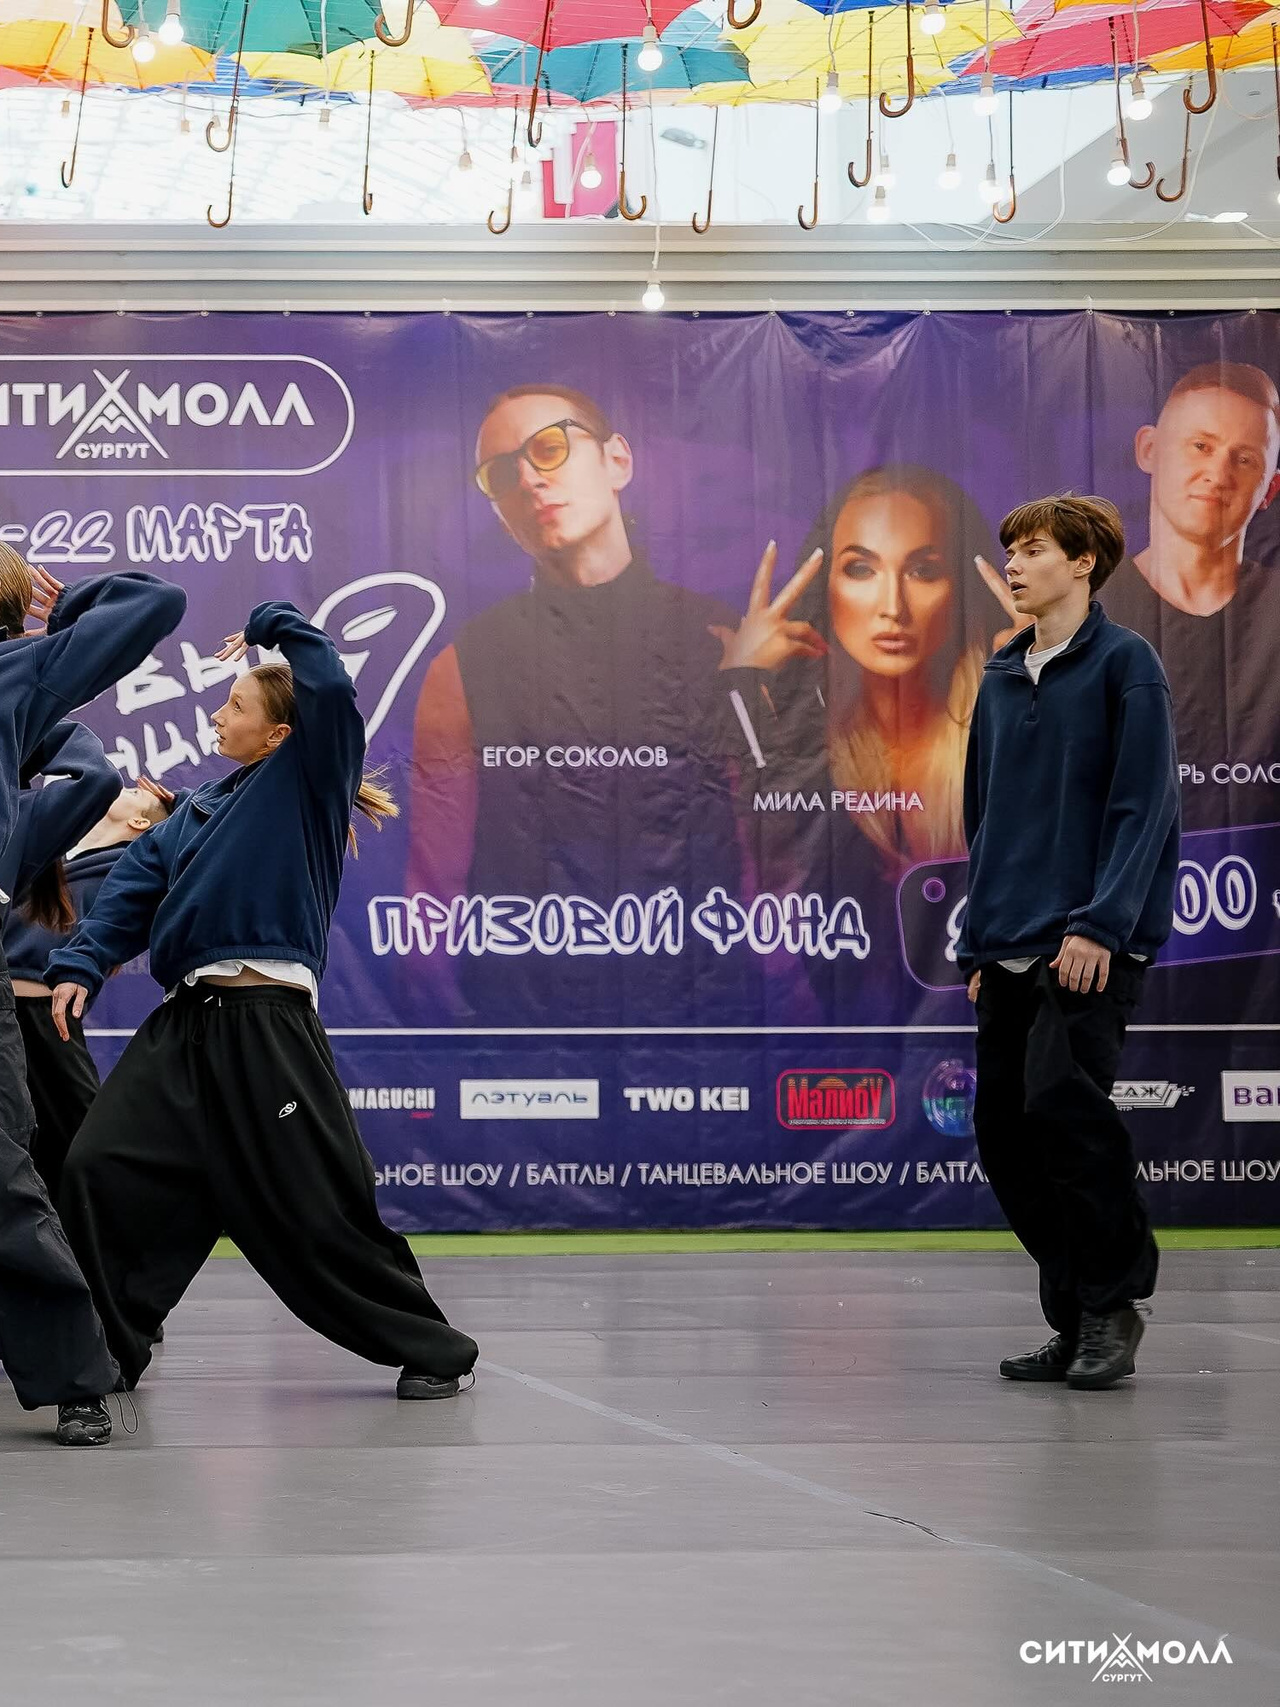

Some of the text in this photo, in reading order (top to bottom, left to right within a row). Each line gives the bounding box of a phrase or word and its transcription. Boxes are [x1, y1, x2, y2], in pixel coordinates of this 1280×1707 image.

[74, 442, 150, 460] СУРГУТ
[126, 503, 314, 563] МАРТА
[483, 746, 669, 768] ЕГОР СОКОЛОВ
[752, 791, 924, 815] МИЛА РЕДИНА
[368, 886, 684, 956] ПРИЗОВОЙ
[692, 885, 870, 960] ФОНД
[348, 1086, 436, 1110] MAGUCHI
[623, 1087, 749, 1112] TWO KEI
[374, 1162, 437, 1187] ЬНОЕ
[441, 1162, 504, 1187] ШОУ
[526, 1162, 615, 1187] БАТТЛЫ
[637, 1161, 826, 1187] ТАНЦЕВАЛЬНОЕ
[832, 1161, 893, 1185] ШОУ
[916, 1161, 989, 1184] БАТТЛ
[1135, 1160, 1216, 1182] ЛЬНОЕ
